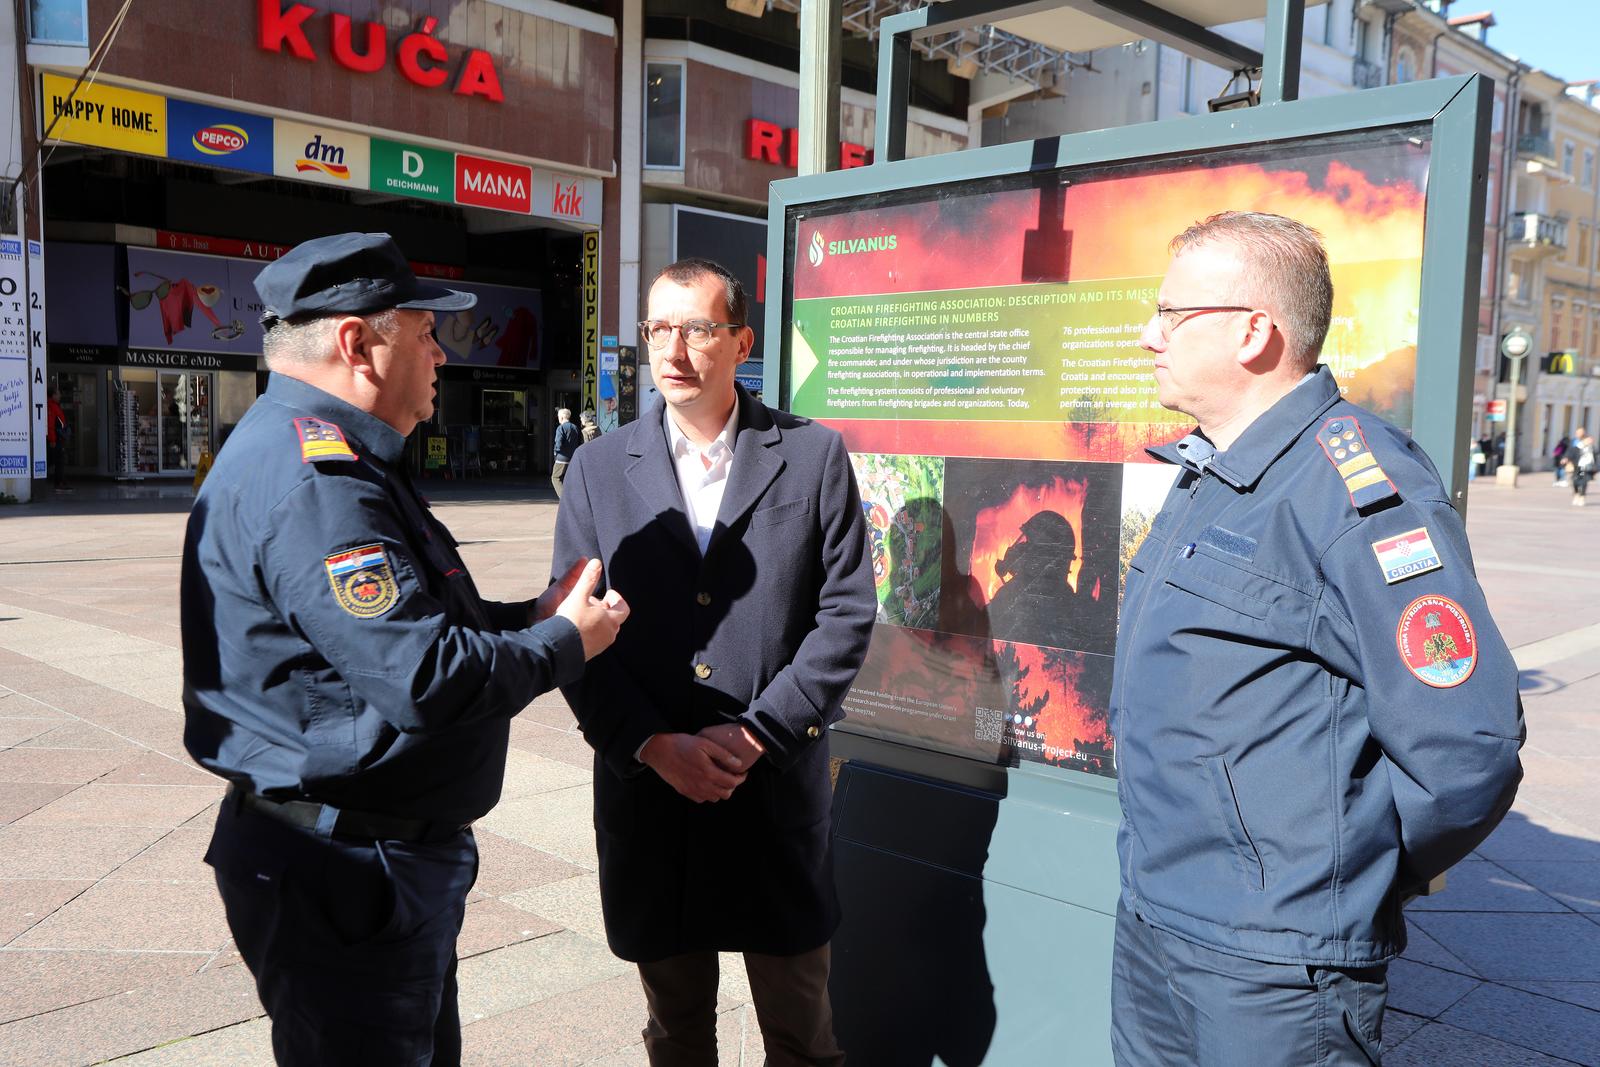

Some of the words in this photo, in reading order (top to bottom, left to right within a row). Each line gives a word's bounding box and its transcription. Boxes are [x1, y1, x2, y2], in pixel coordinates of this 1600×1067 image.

[257, 0, 505, 103] KUĆA
[53, 95, 104, 123] HAPPY
[111, 106, 158, 133] HOME.
[201, 131, 241, 148] PEPCO
[304, 135, 345, 164] dm
[402, 150, 424, 178] D
[386, 177, 439, 194] DEICHMANN
[463, 168, 526, 200] MANA
[243, 243, 284, 259] AUT
[828, 235, 897, 256] SILVANUS
[586, 236, 597, 321] OTKUP
[31, 292, 42, 310] 2.
[830, 306, 873, 316] CROATIAN
[875, 302, 937, 313] FIREFIGHTING
[939, 297, 1006, 310] ASSOCIATION:
[1008, 293, 1077, 307] DESCRIPTION
[1079, 291, 1103, 303] AND
[1106, 290, 1123, 301] ITS
[1126, 288, 1160, 300] MISSI
[830, 318, 872, 329] CROATIAN
[874, 315, 937, 327] FIREFIGHTING
[939, 314, 949, 324] IN
[951, 312, 999, 324] NUMBERS
[829, 335, 840, 344] The
[841, 335, 868, 343] Croatian
[869, 333, 904, 343] Firefighting
[906, 332, 943, 341] Association
[944, 332, 951, 340] is
[951, 330, 963, 340] the
[964, 330, 989, 340] central
[990, 329, 1008, 338] state
[1009, 328, 1030, 337] office
[1063, 326, 1072, 335] 76
[1073, 324, 1122, 336] professional
[828, 346, 864, 356] responsible
[864, 346, 874, 354] for
[875, 346, 907, 355] managing
[908, 345, 945, 354] firefighting.
[960, 343, 987, 352] headed
[988, 342, 997, 352] by
[998, 342, 1011, 351] the
[1011, 341, 1031, 350] chief
[1062, 339, 1114, 350] organizations
[126, 351, 188, 366] MASKICE
[190, 355, 222, 368] eMDe
[828, 359, 838, 367] fire
[839, 359, 878, 367] commander,
[879, 358, 891, 366] and
[892, 358, 913, 366] under
[914, 357, 936, 366] whose
[936, 356, 974, 366] jurisdiction
[988, 355, 1001, 364] the
[1001, 355, 1027, 365] county
[1062, 359, 1076, 368] The
[1077, 358, 1111, 367] Croatian
[32, 330, 43, 420] KAT
[584, 328, 595, 412] ZLATA
[827, 370, 861, 380] firefighting
[911, 369, 949, 379] operational
[950, 369, 963, 377] and
[964, 368, 1021, 378] implementation
[1022, 368, 1046, 376] terms.
[1060, 372, 1089, 381] Croatia
[1090, 372, 1106, 381] and
[827, 387, 839, 395] The
[840, 387, 874, 396] firefighting
[874, 388, 898, 396] system
[898, 387, 924, 395] consists
[925, 386, 933, 394] of
[933, 386, 975, 396] professional
[976, 386, 989, 395] and
[991, 386, 1025, 396] voluntary
[1060, 386, 1101, 396] protection
[1103, 386, 1118, 394] and
[1120, 386, 1137, 394] also
[827, 399, 861, 408] firefighters
[862, 399, 877, 407] from
[878, 399, 913, 408] firefighting
[914, 399, 942, 408] brigades
[943, 399, 956, 407] and
[957, 399, 1005, 409] organizations.
[1008, 399, 1030, 409] Today,
[1060, 399, 1092, 409] perform
[1105, 401, 1137, 410] average
[1139, 399, 1148, 408] of
[1391, 559, 1435, 578] CROATIA
[1403, 599, 1444, 632] VATROGASNA
[1445, 603, 1471, 643] POSTROJBA
[1402, 633, 1412, 657] JAVNA
[1003, 725, 1026, 736] Follow
[1026, 729, 1035, 738] us
[1002, 735, 1087, 761] Silvanus-Project.eu
